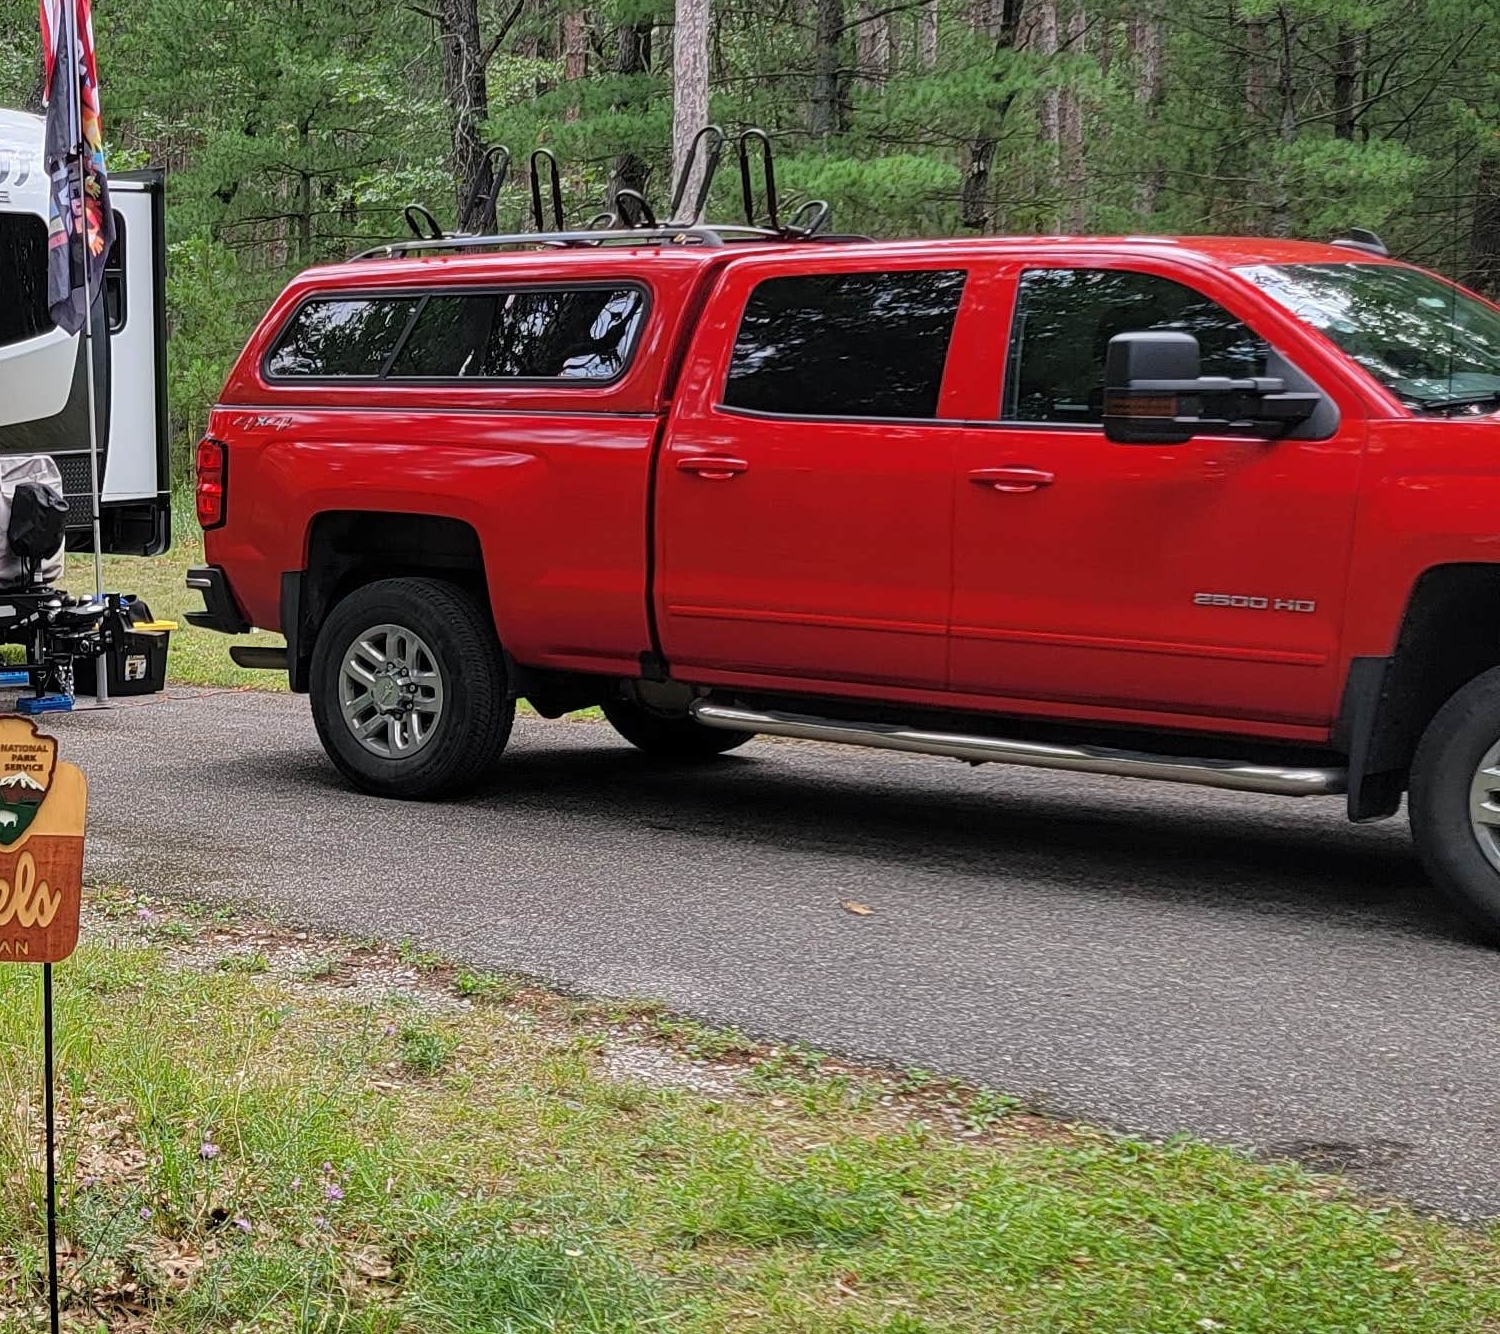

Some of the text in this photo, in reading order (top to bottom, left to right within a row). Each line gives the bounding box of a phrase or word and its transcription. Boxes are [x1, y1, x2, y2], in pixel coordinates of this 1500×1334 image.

[1194, 592, 1316, 612] 2500 HD
[0, 744, 48, 753] NATIONAL
[11, 754, 37, 762] PARK
[4, 763, 44, 772] SERVICE
